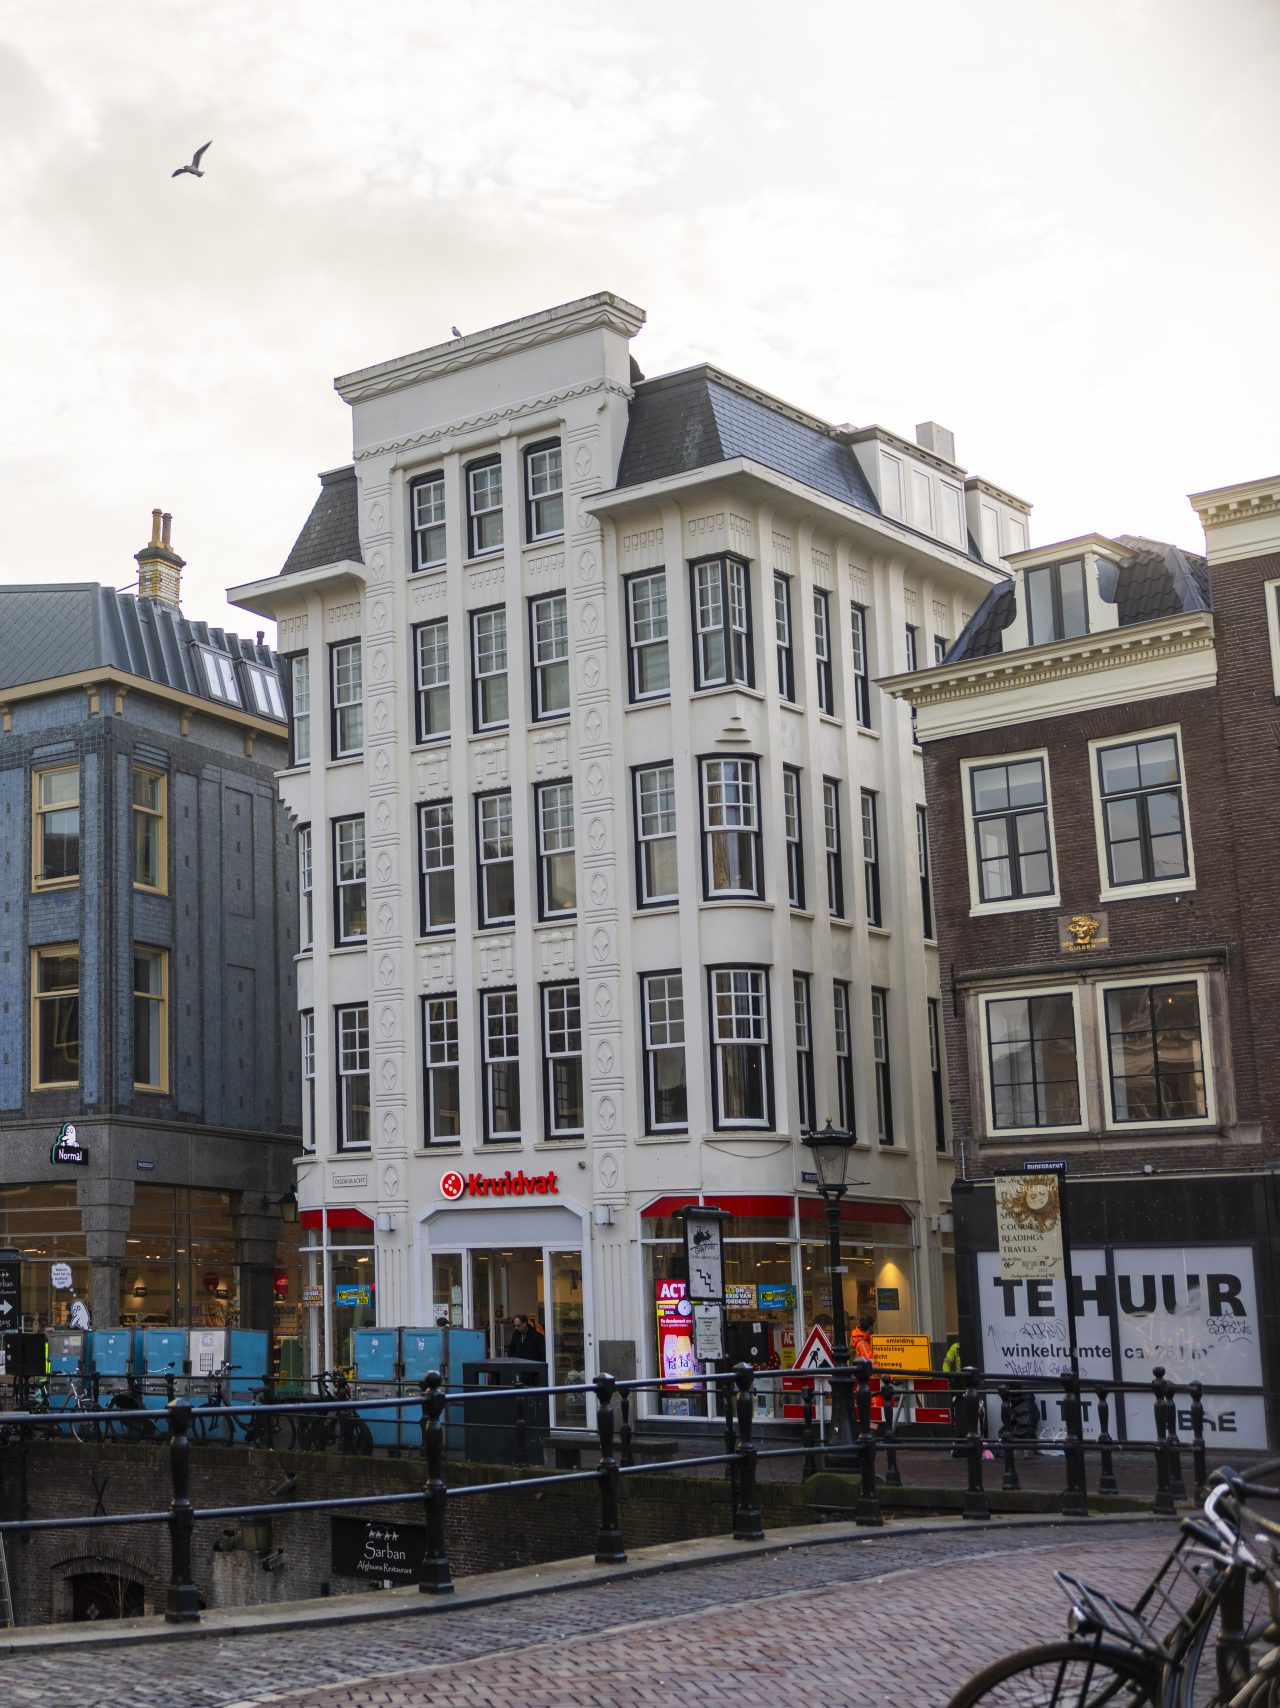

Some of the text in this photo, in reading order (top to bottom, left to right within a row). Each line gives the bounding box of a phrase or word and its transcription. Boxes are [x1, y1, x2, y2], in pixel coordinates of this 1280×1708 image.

[58, 1148, 83, 1161] Normal
[335, 1177, 366, 1185] OUDEGRACHT
[469, 1170, 559, 1196] Kruidvat
[1002, 1234, 1044, 1243] READINGS
[660, 1283, 687, 1298] ACT
[994, 1275, 1247, 1318] TE HUUR
[1002, 1343, 1111, 1359] winkelrumte
[363, 1540, 406, 1560] Sarban
[356, 1560, 413, 1574] Afghaans Restaurant
